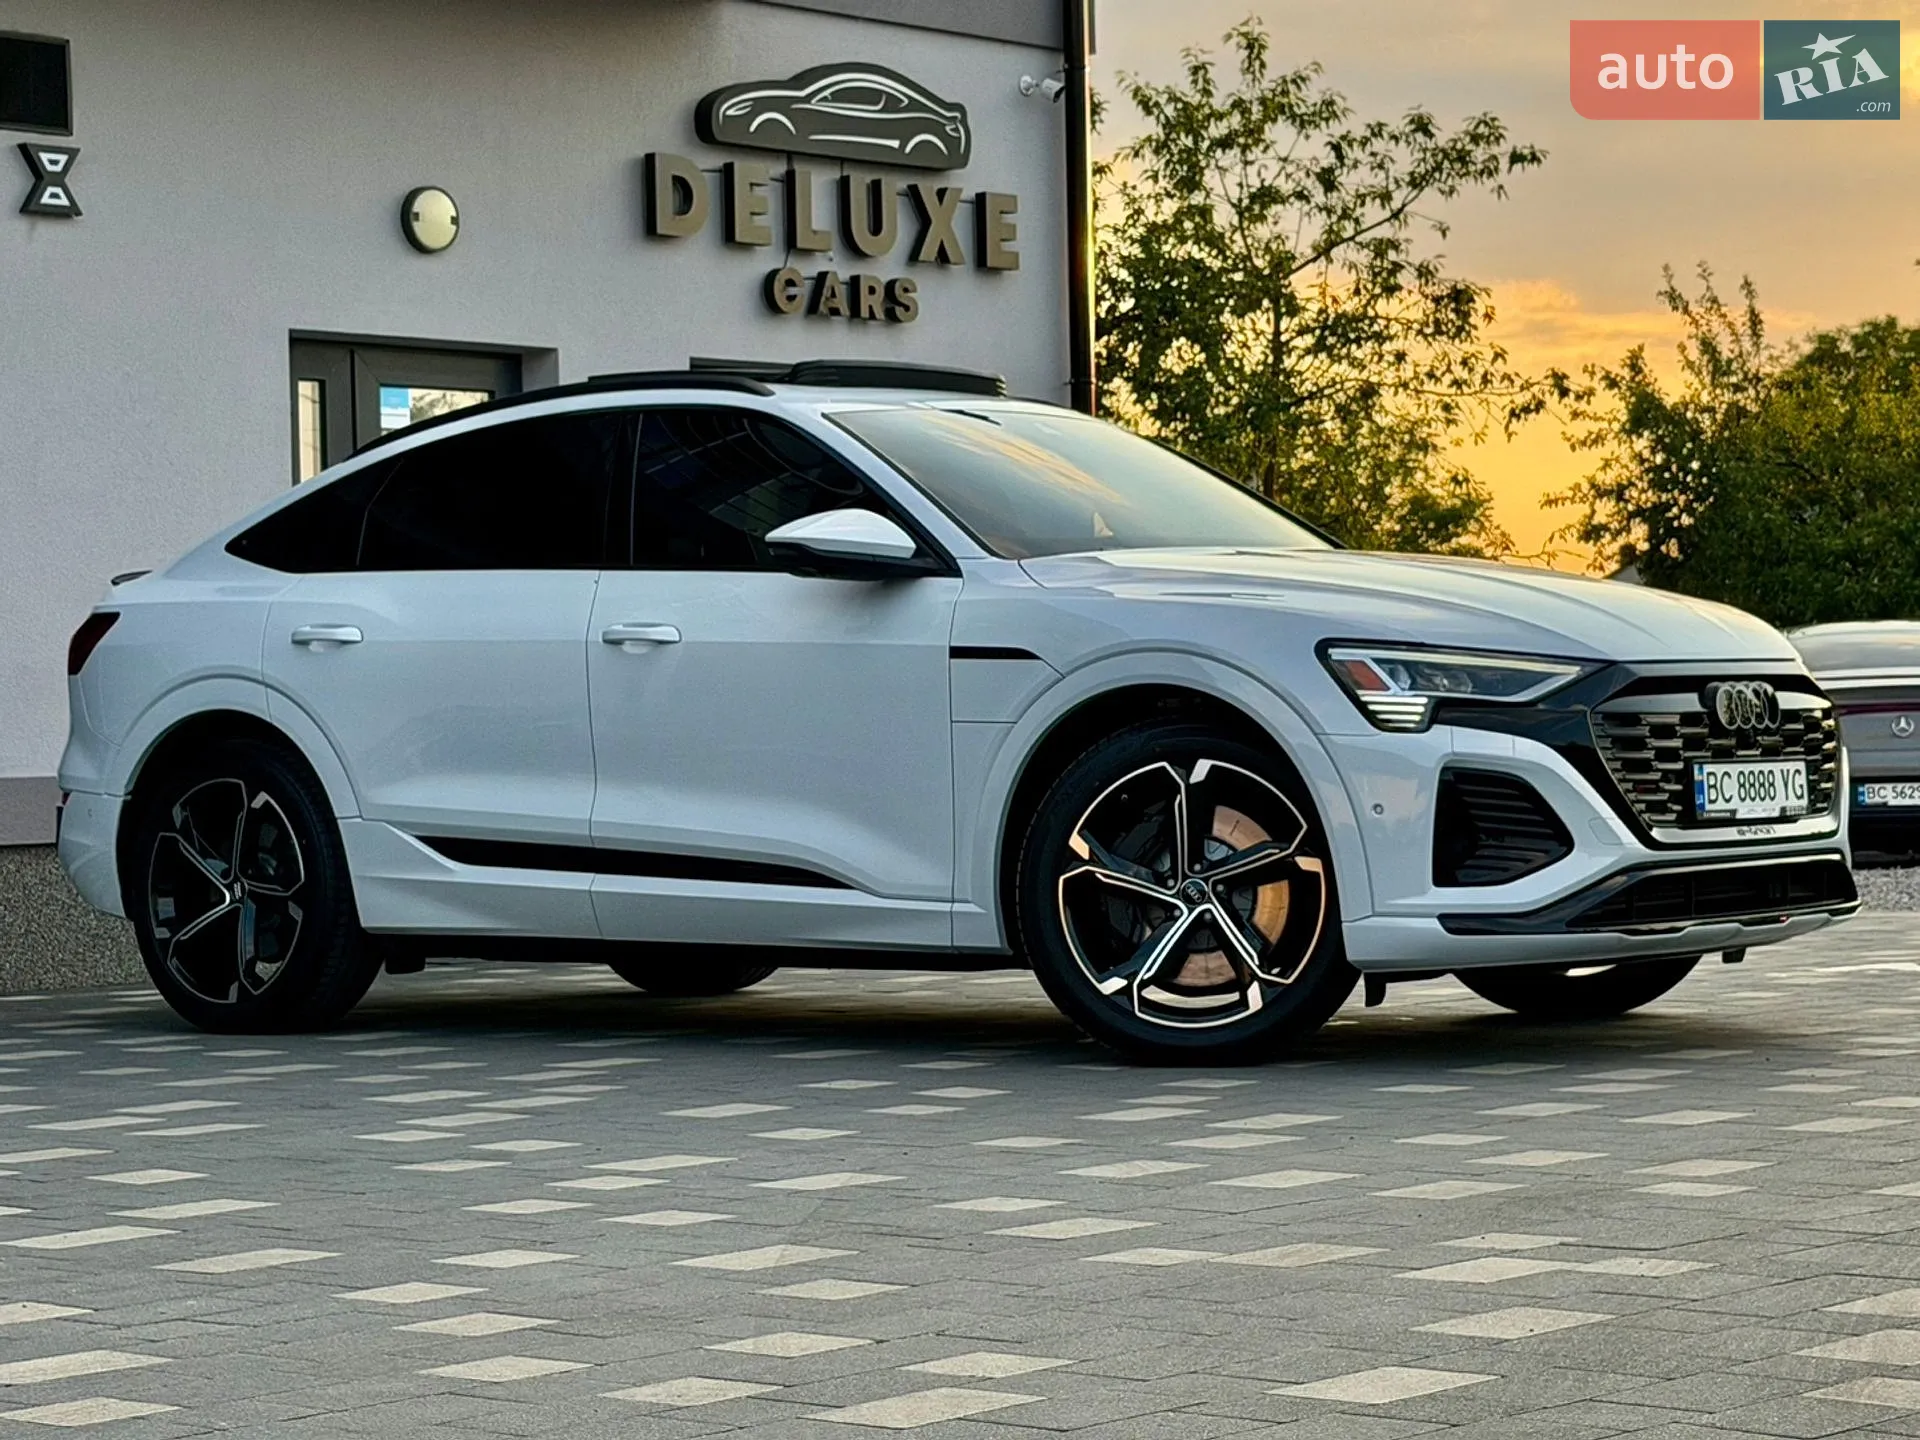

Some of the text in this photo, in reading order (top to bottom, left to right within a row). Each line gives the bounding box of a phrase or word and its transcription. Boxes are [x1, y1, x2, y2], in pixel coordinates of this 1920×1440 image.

[644, 152, 1020, 271] DELUXE
[763, 267, 920, 324] CARS
[1706, 768, 1805, 804] BC 8888 YG
[1865, 785, 1888, 800] BC
